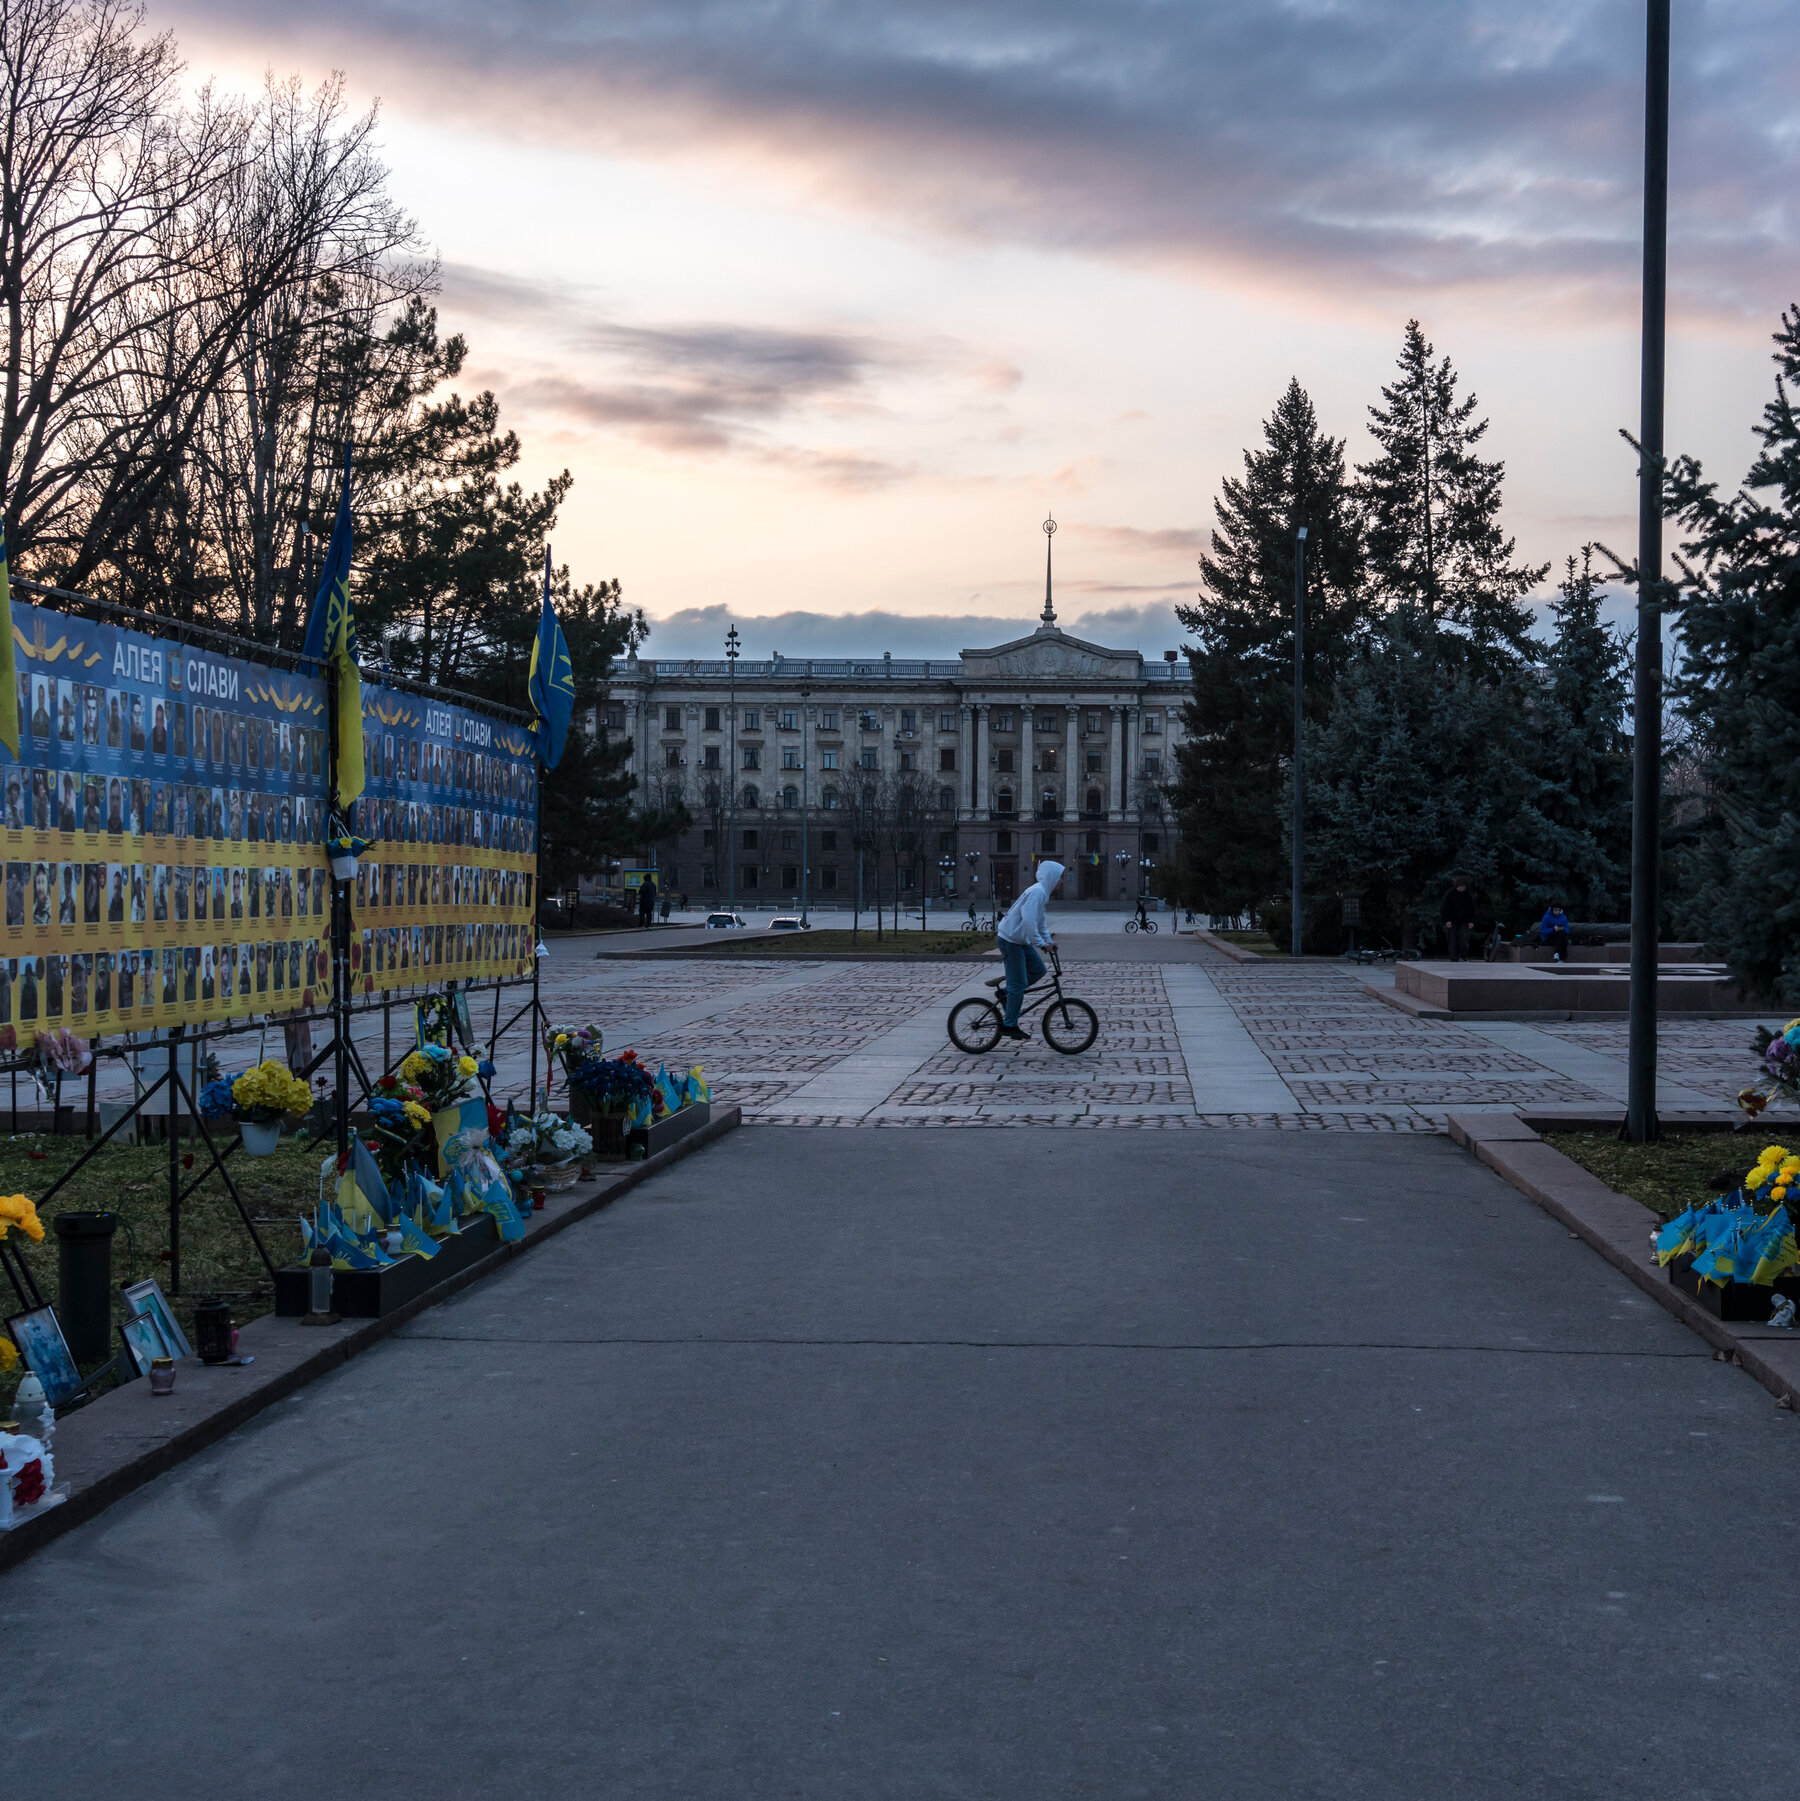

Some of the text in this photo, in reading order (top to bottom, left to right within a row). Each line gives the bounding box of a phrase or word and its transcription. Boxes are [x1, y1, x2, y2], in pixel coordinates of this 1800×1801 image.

[112, 641, 239, 702] АЛЕЯ СЛАВИ
[425, 708, 492, 748] АЛЕЯ СЛАВИ
